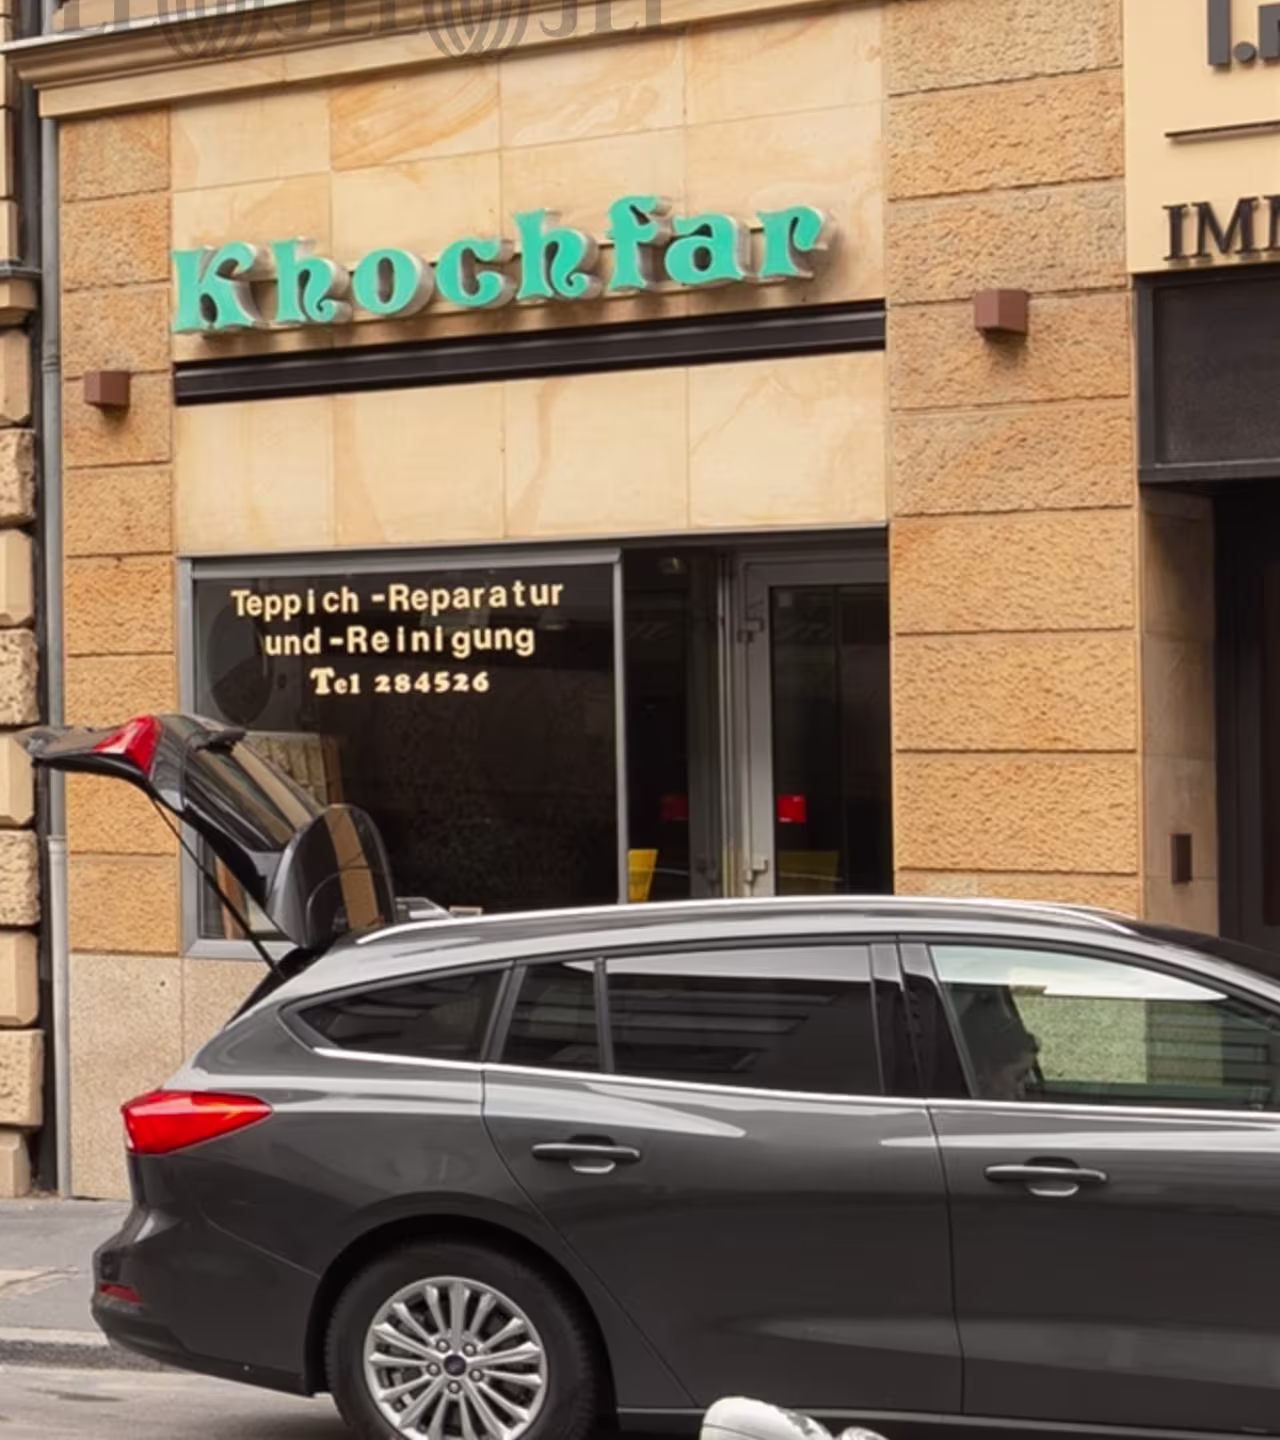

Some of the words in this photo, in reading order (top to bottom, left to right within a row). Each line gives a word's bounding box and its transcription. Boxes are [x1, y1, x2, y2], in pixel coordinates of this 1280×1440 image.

[172, 195, 828, 336] Khochfar
[231, 586, 358, 622] Teppich
[310, 667, 360, 694] Tel
[374, 671, 490, 694] 284526
